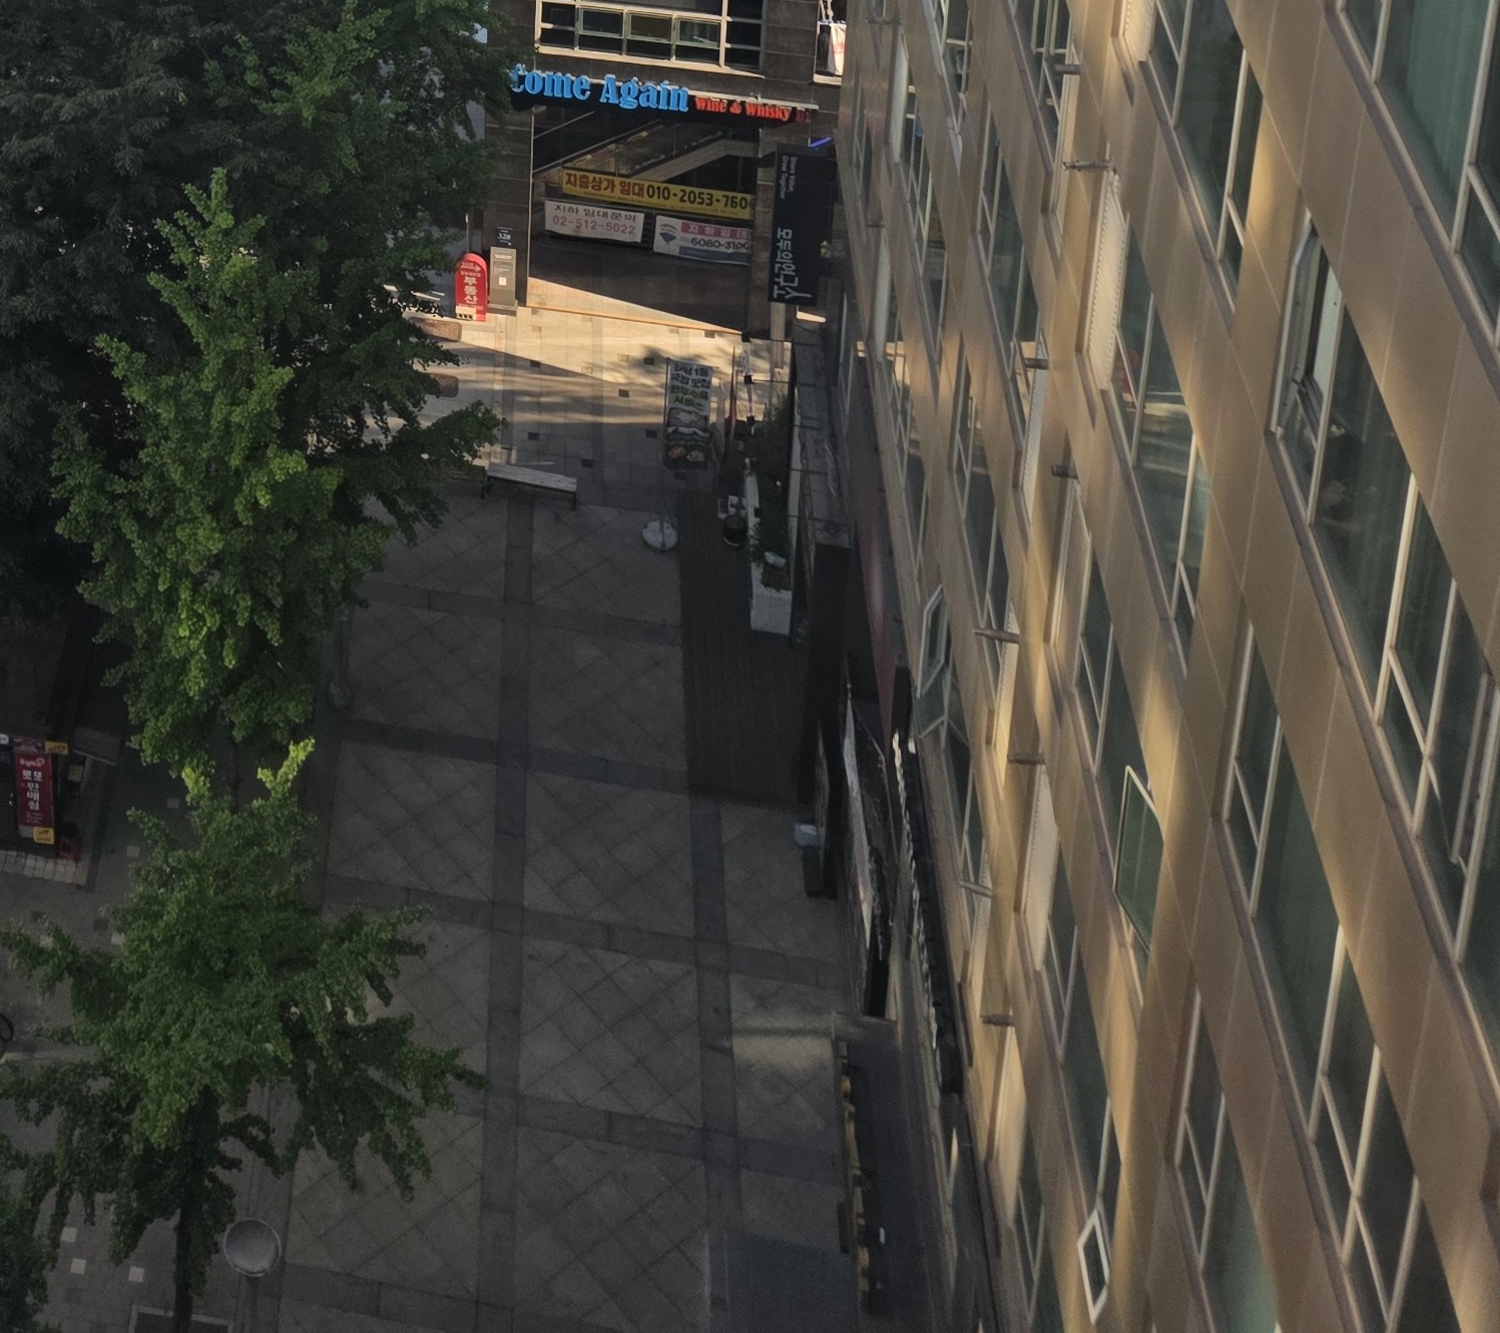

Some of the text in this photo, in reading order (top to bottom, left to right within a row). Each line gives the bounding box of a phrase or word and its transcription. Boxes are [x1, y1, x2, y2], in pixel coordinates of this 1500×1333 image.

[600, 73, 689, 112] Again
[694, 96, 727, 114] Wine
[745, 101, 792, 122] Whisky
[564, 171, 617, 194] 지층상가
[619, 181, 645, 198] 임대
[554, 205, 579, 216] 지하
[552, 214, 636, 235] 02-512-5022
[773, 227, 812, 299] 모두의연구소
